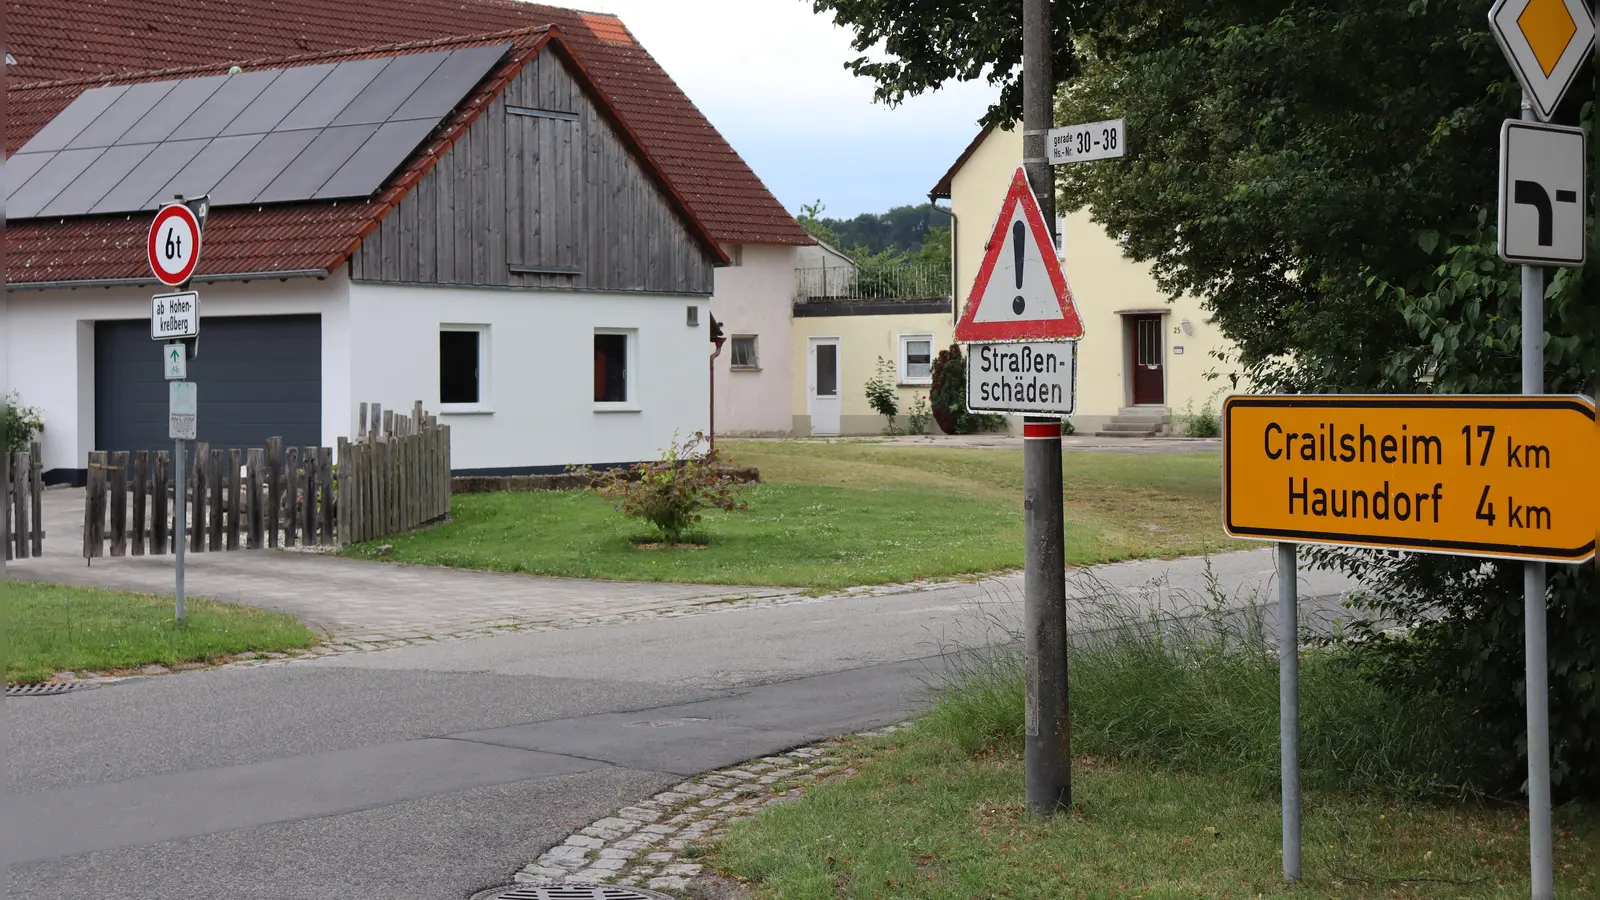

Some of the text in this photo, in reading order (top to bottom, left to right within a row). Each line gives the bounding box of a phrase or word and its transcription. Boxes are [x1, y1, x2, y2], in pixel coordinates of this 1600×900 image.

[1053, 133, 1073, 147] gerade
[156, 298, 192, 315] ab Hohen-
[159, 315, 189, 334] kreßberg
[980, 345, 1066, 373] Straßen-
[980, 375, 1062, 403] schäden
[1264, 422, 1550, 469] Crailsheim 17 km
[1288, 476, 1551, 530] Haundorf 4 km
